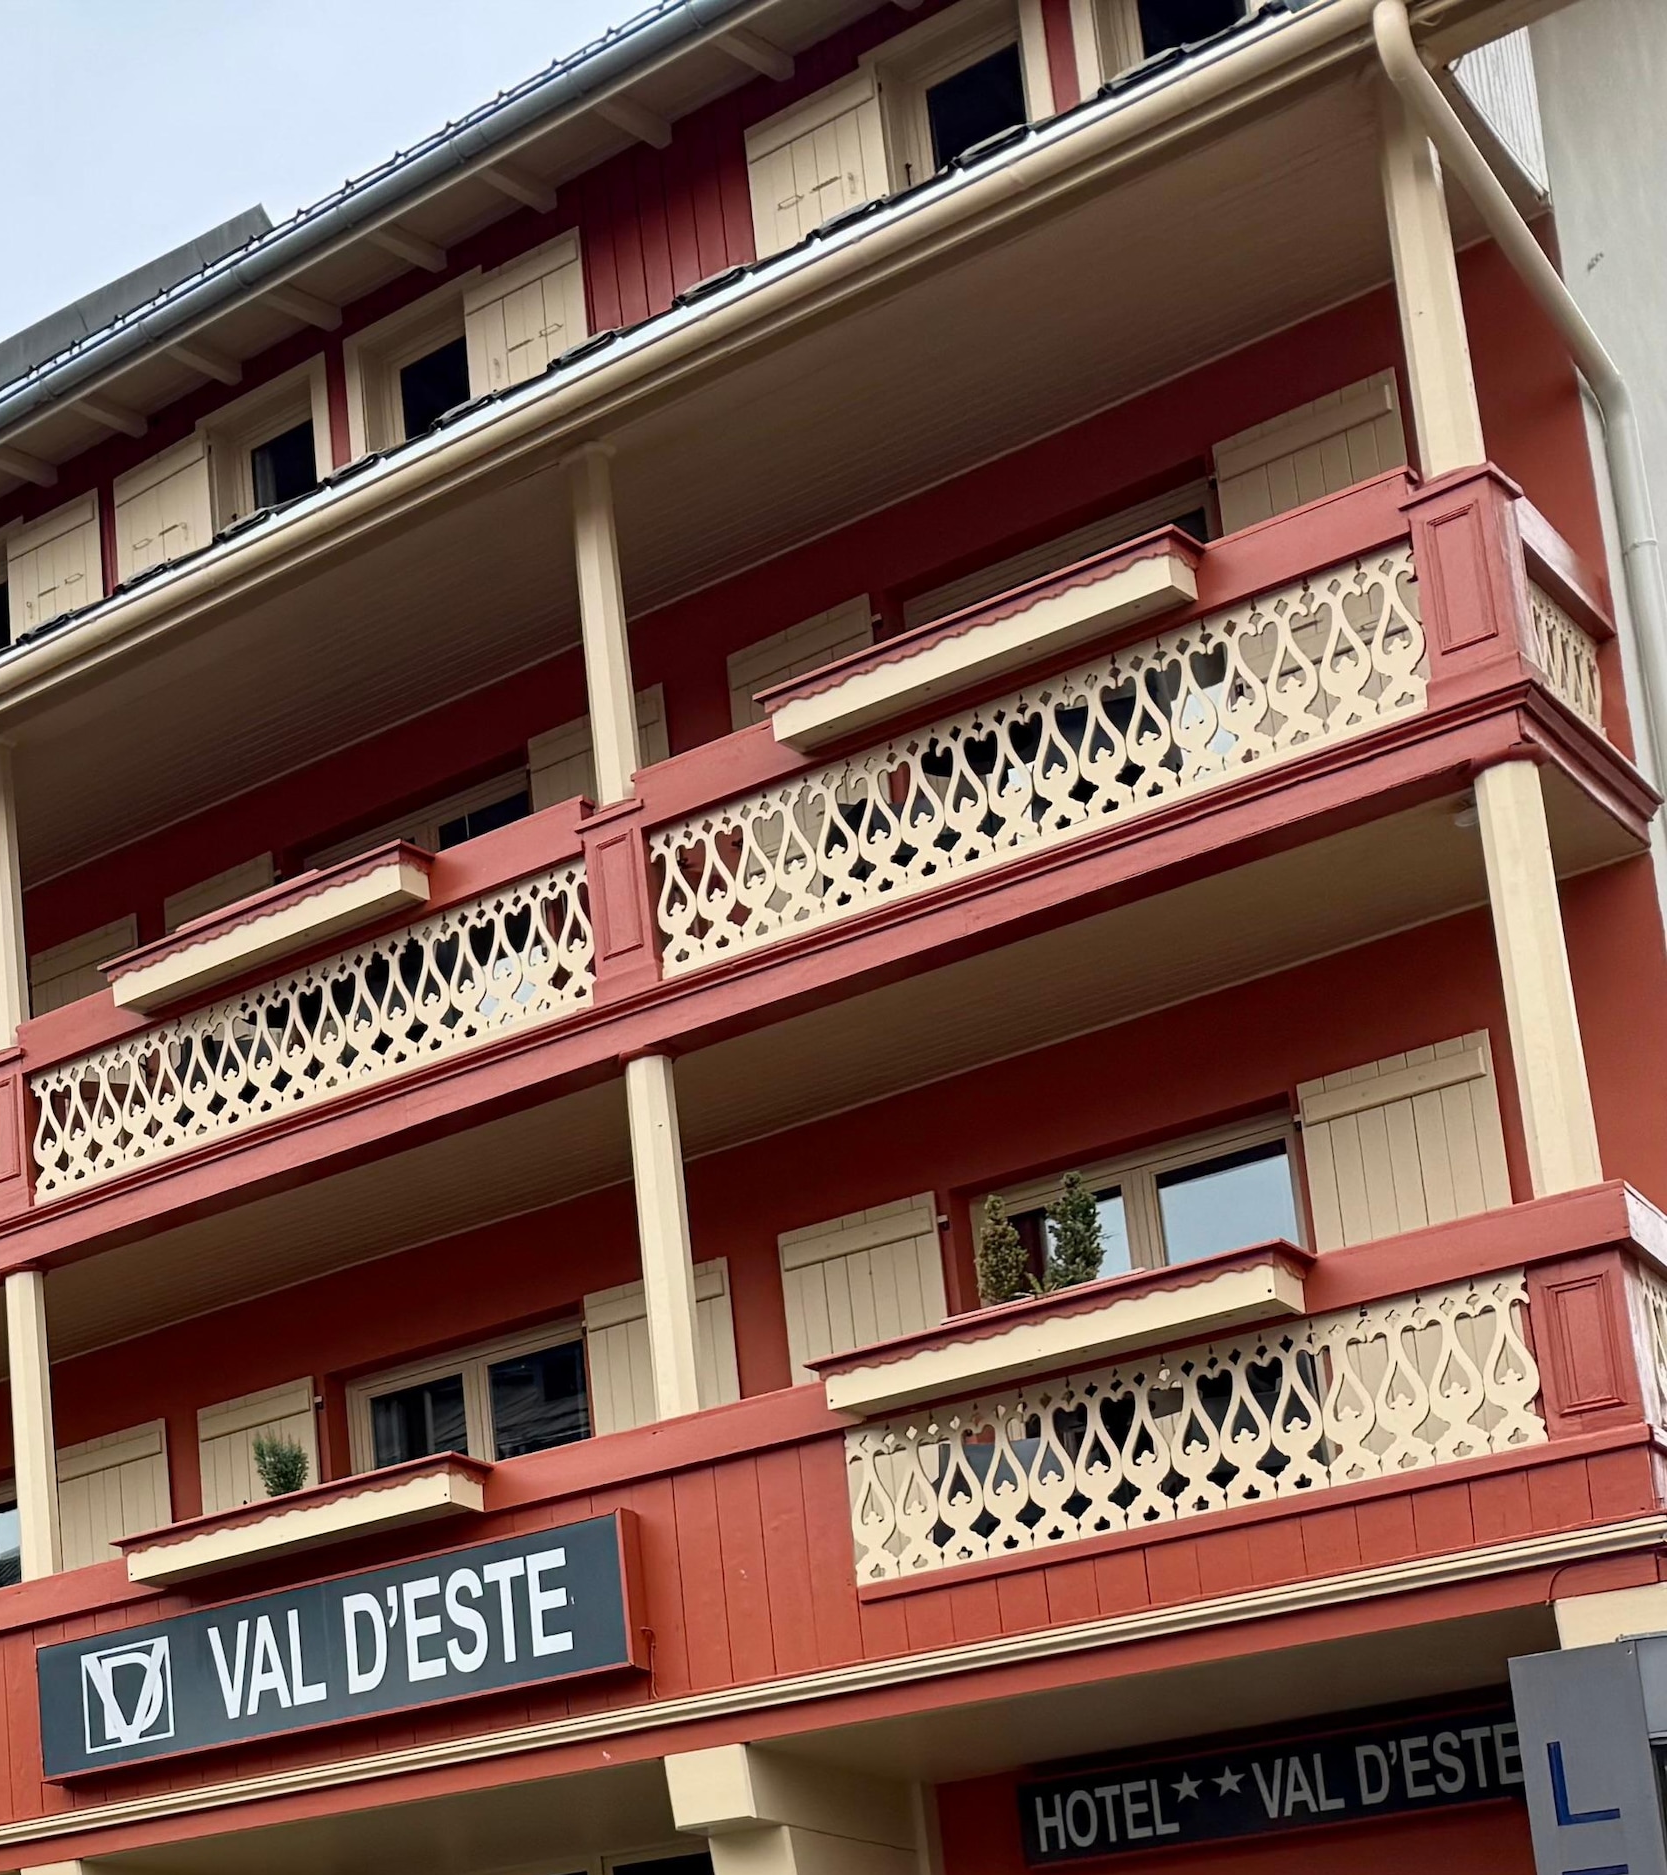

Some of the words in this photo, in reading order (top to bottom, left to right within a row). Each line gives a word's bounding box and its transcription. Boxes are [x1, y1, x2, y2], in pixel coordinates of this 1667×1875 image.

[208, 1609, 327, 1720] VAL
[342, 1546, 574, 1695] D'ESTE
[1035, 1779, 1180, 1853] HOTEL
[1252, 1753, 1345, 1819] VAL
[1355, 1721, 1526, 1806] D'ESTE
